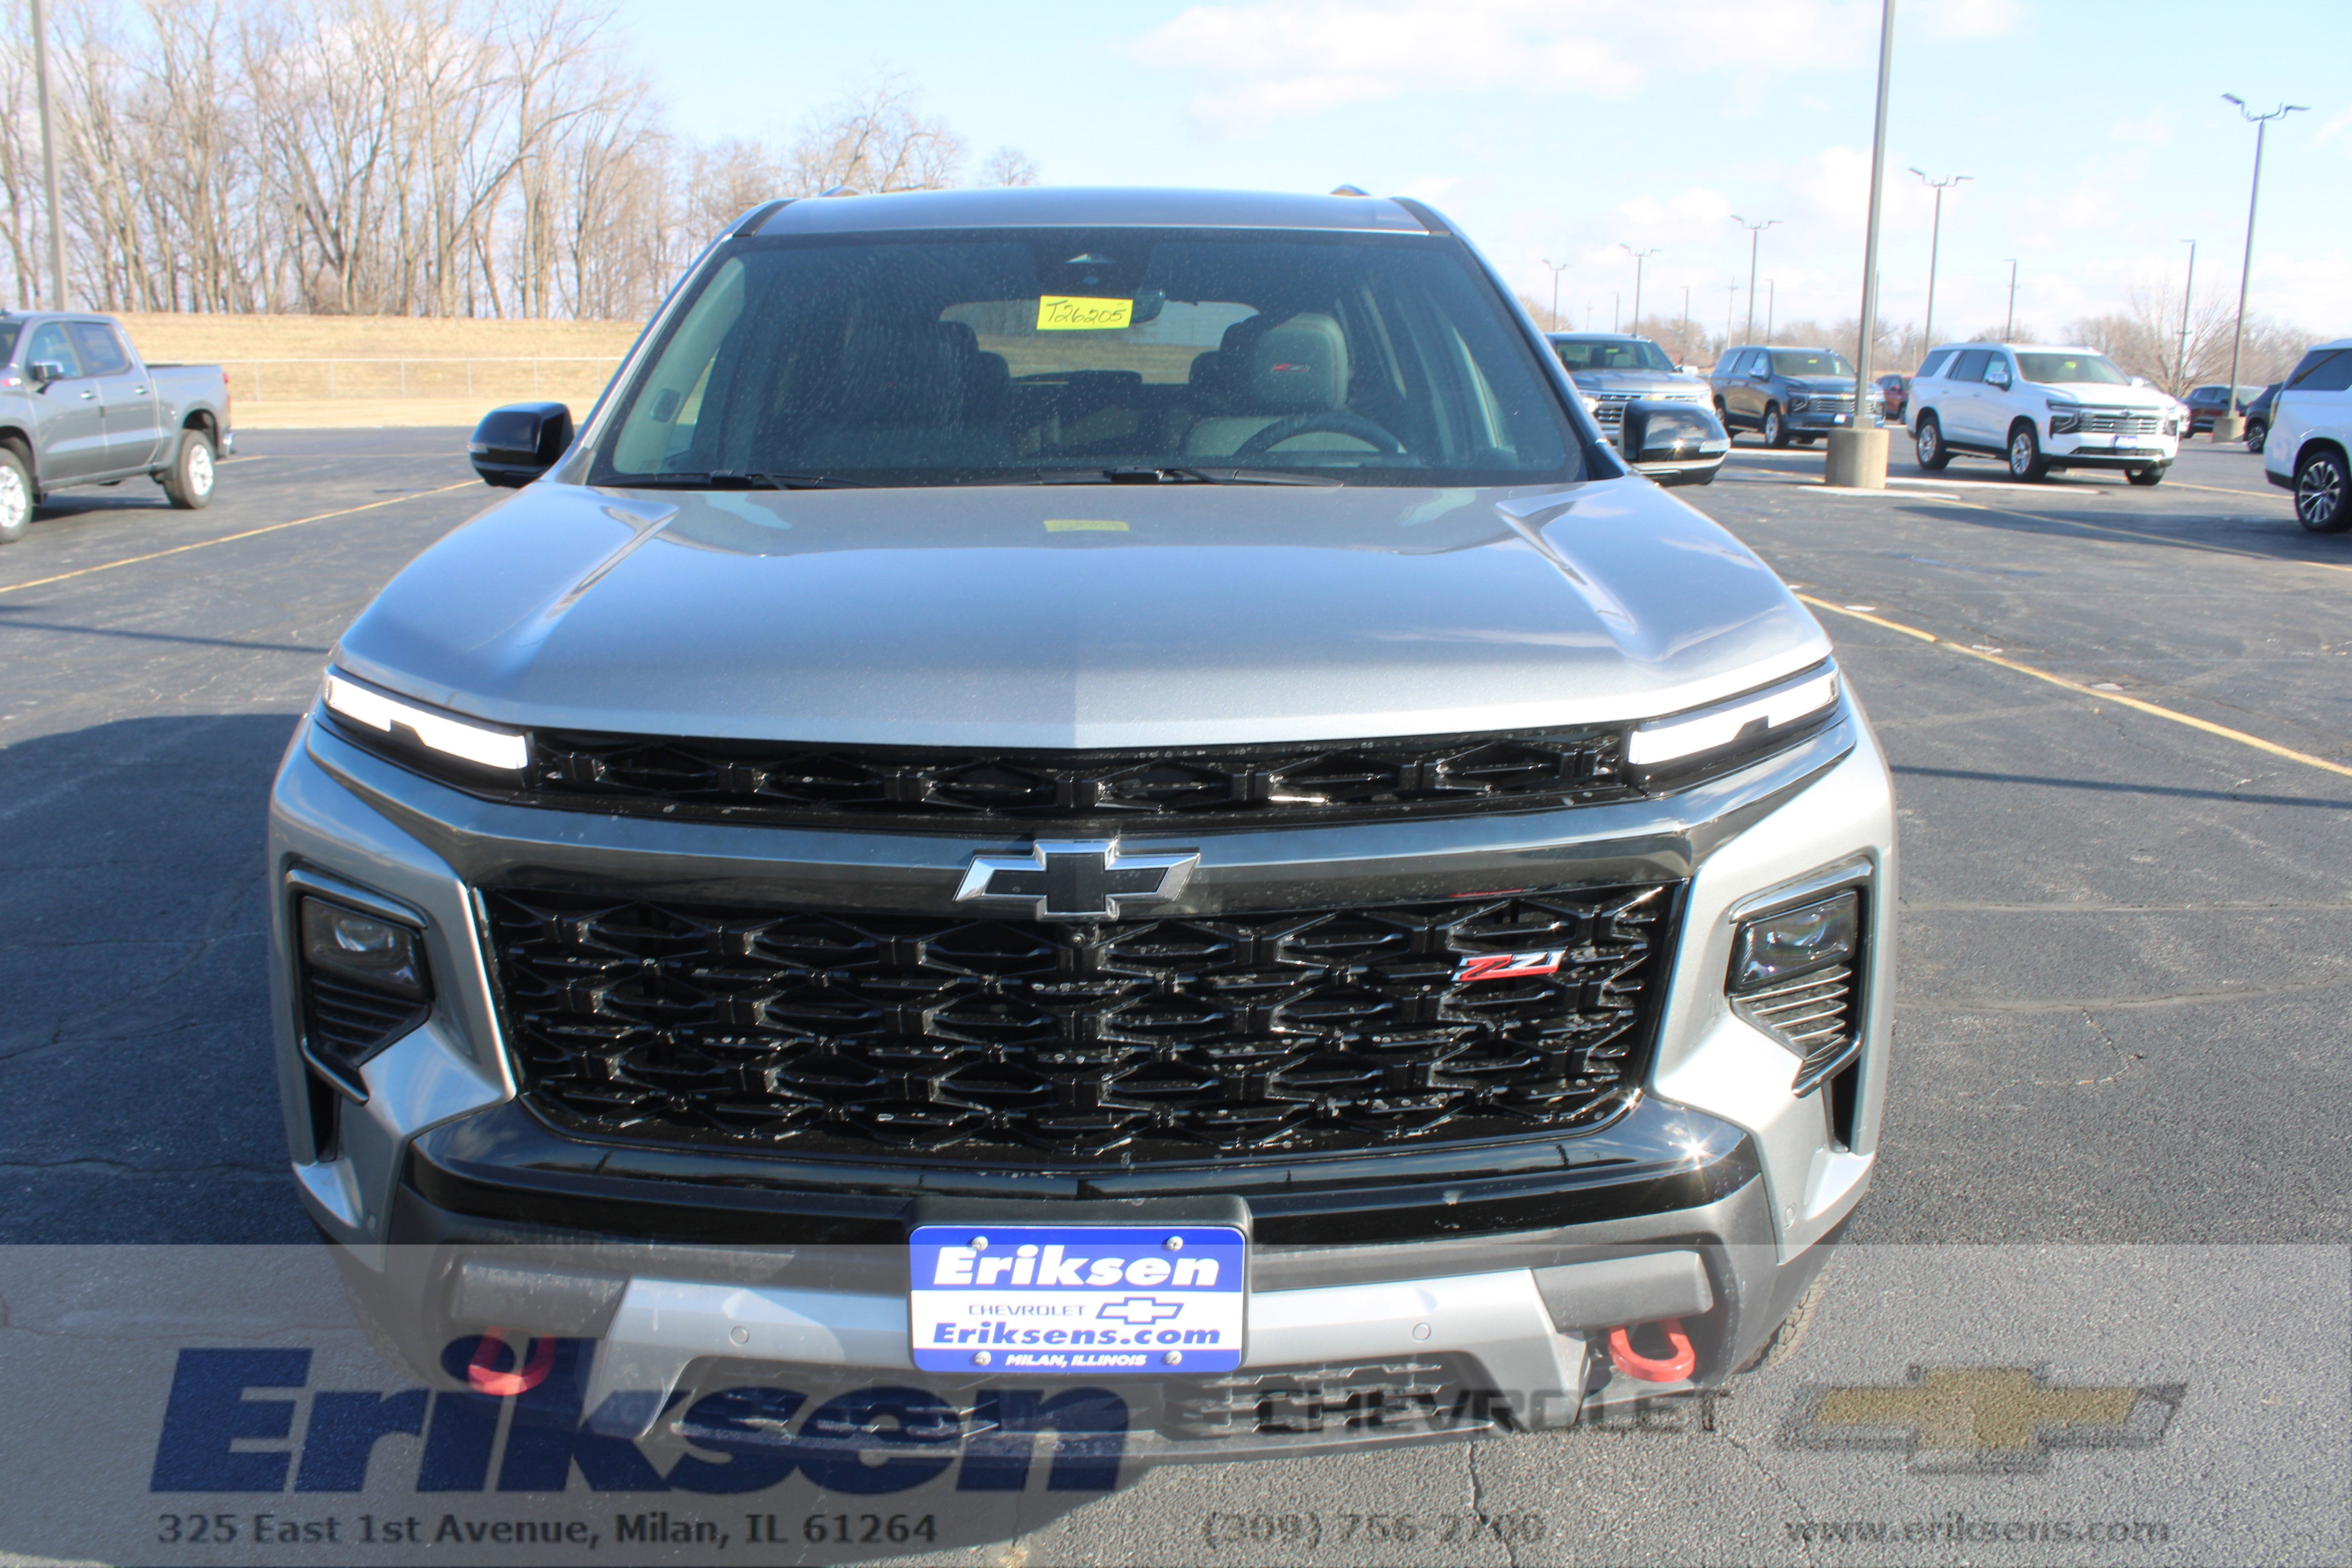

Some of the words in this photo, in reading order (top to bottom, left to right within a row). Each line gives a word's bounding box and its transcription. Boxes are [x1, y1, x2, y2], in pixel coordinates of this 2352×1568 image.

[1046, 299, 1127, 324] T26205
[1451, 949, 1567, 982] Z71
[933, 1244, 1220, 1287] Eriksen
[969, 1305, 1087, 1316] CHEVROLET
[933, 1321, 1221, 1345] Eriksens.com
[1005, 1354, 1068, 1368] MILAN,
[1071, 1354, 1147, 1367] ILLINOIS
